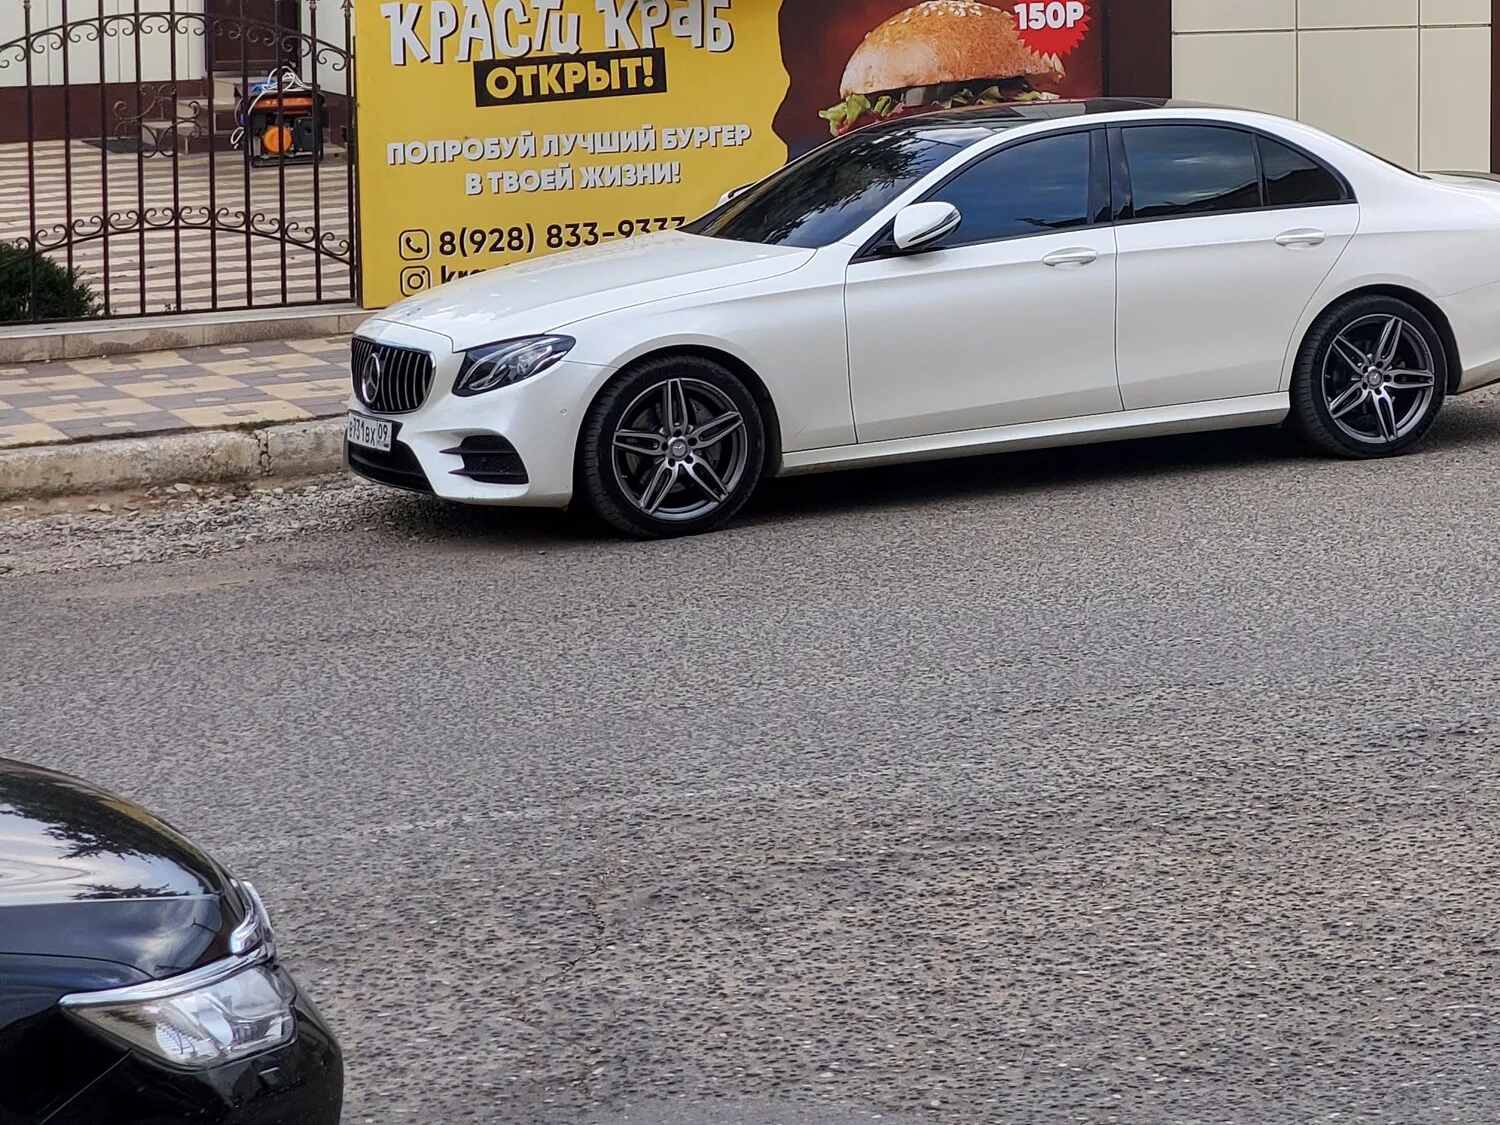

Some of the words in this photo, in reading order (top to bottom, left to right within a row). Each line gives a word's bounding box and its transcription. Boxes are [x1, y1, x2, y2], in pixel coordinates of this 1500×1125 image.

[1013, 1, 1084, 30] 150Р
[486, 56, 656, 100] ОТКРЫТ!
[387, 130, 536, 165] ПОПРОБУЙ
[542, 124, 657, 157] ЛУЧШИЙ
[663, 125, 752, 151] БУРГЕР
[465, 173, 483, 195] В
[488, 163, 573, 194] ТВОЕЙ
[579, 162, 681, 188] ЖИЗНИ!
[439, 222, 535, 258] 8(928)
